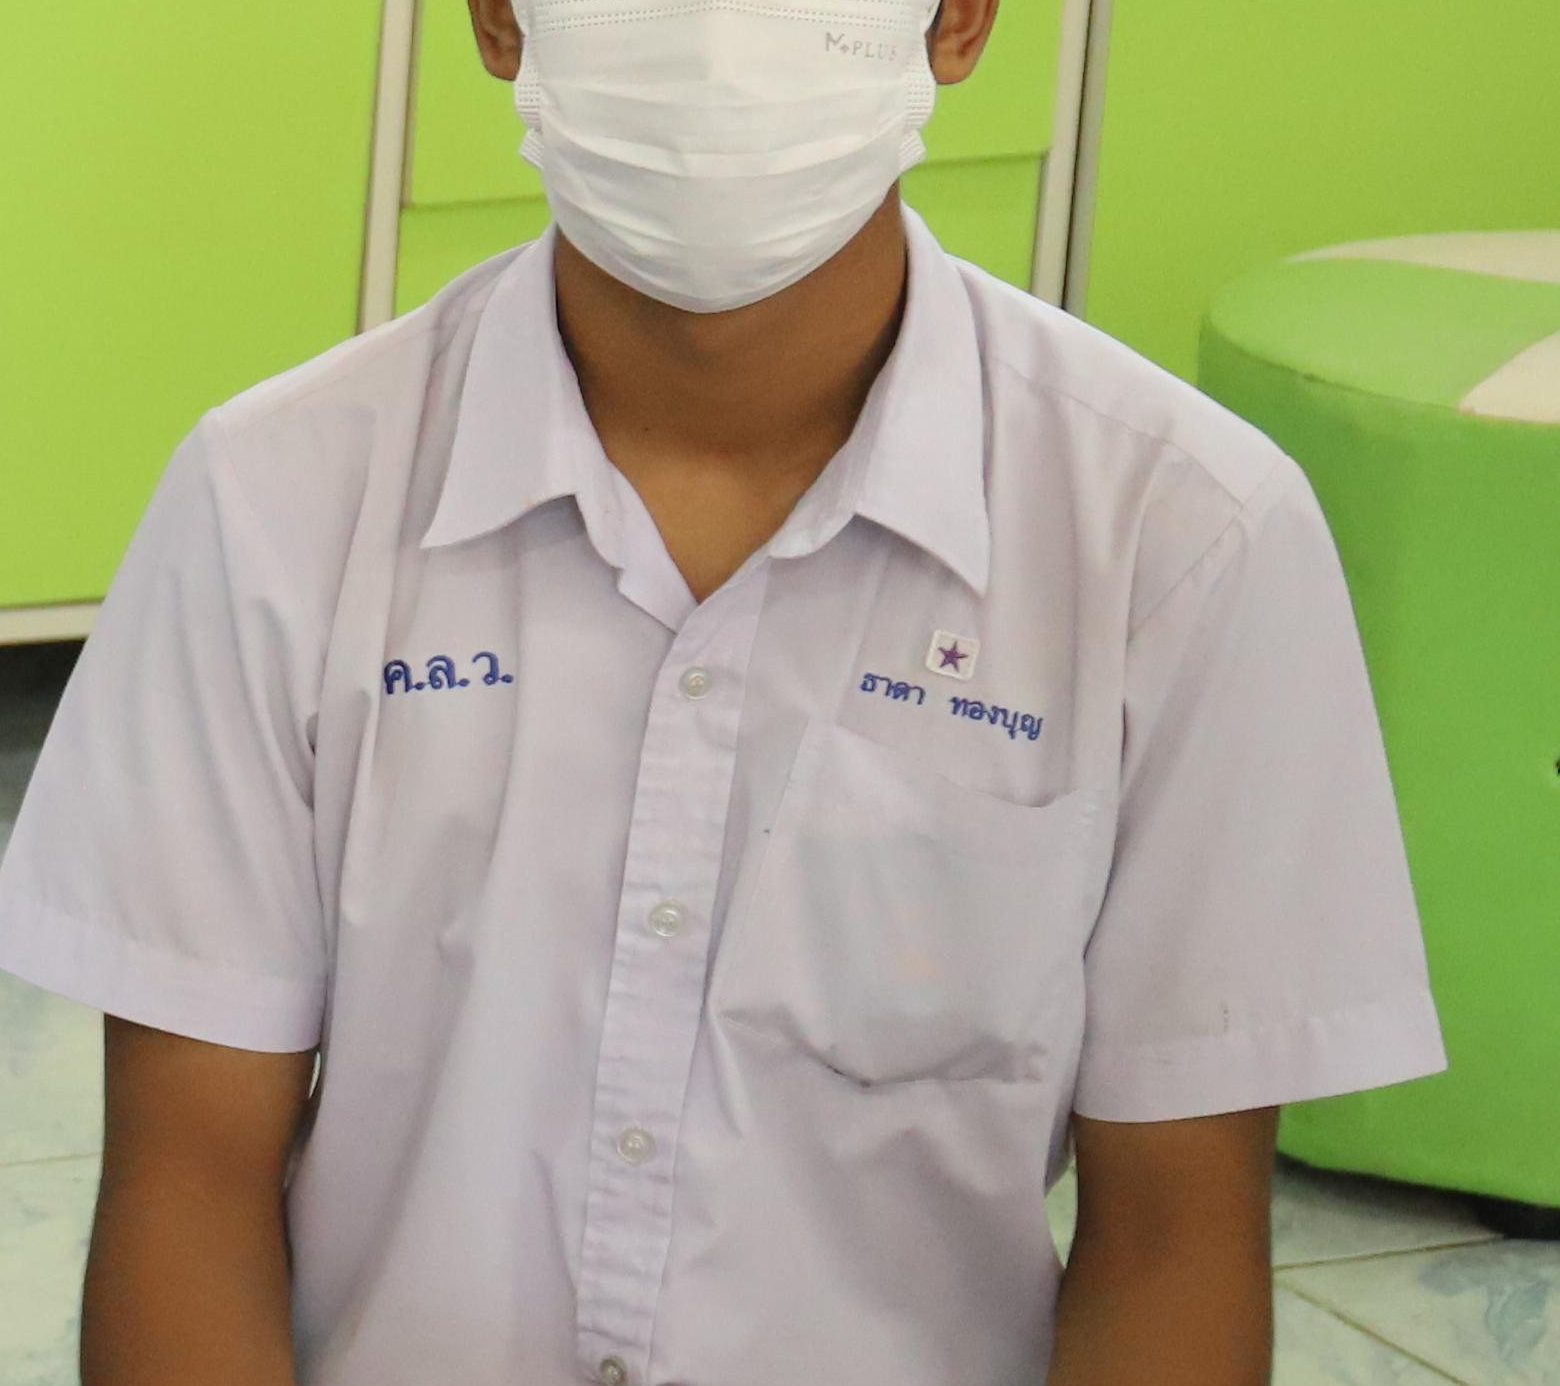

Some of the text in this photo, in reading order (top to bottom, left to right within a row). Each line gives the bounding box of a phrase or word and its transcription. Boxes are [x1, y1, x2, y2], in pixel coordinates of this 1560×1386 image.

[382, 650, 514, 695] ค.ล.ว.
[949, 695, 1044, 741] ทองบุญ
